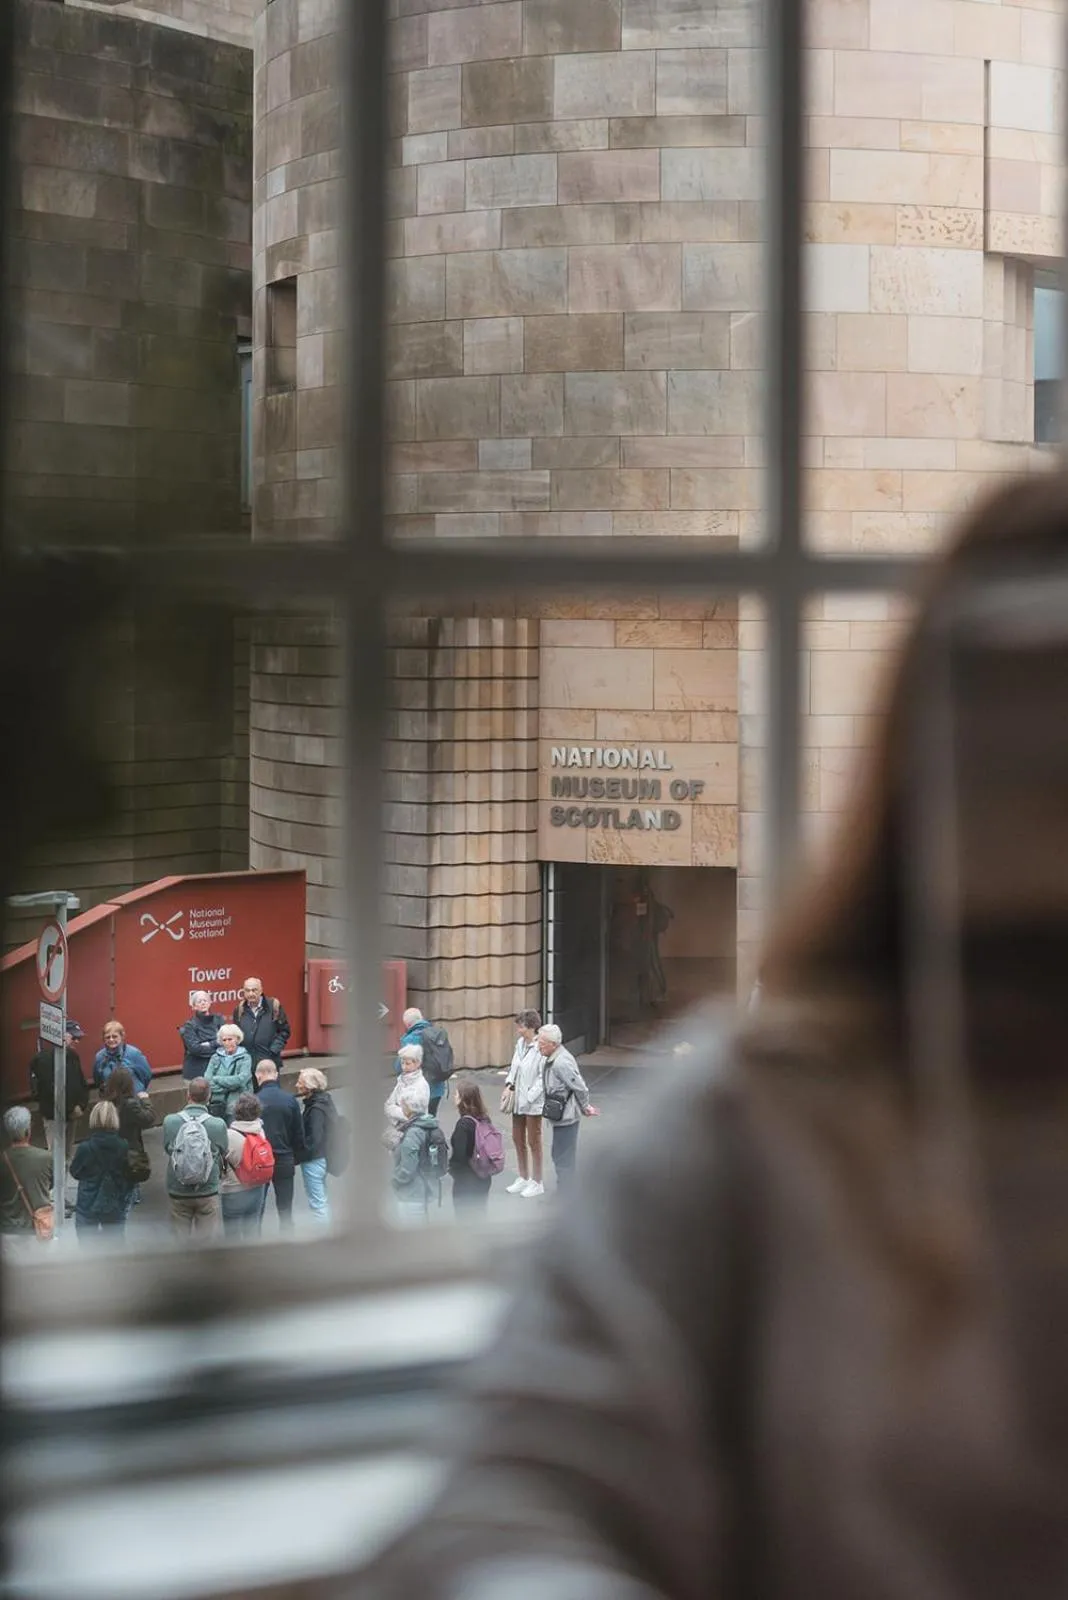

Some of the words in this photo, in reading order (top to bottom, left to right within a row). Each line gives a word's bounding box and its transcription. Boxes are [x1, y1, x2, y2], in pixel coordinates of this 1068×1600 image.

[551, 746, 673, 770] NATIONAL
[551, 776, 661, 800] MUSEUM
[669, 779, 705, 801] OF
[550, 805, 682, 831] SCOTLAND
[189, 907, 225, 918] National
[189, 919, 222, 929] Museum
[223, 916, 232, 926] of
[189, 928, 225, 939] Scotland
[188, 967, 232, 983] Tower
